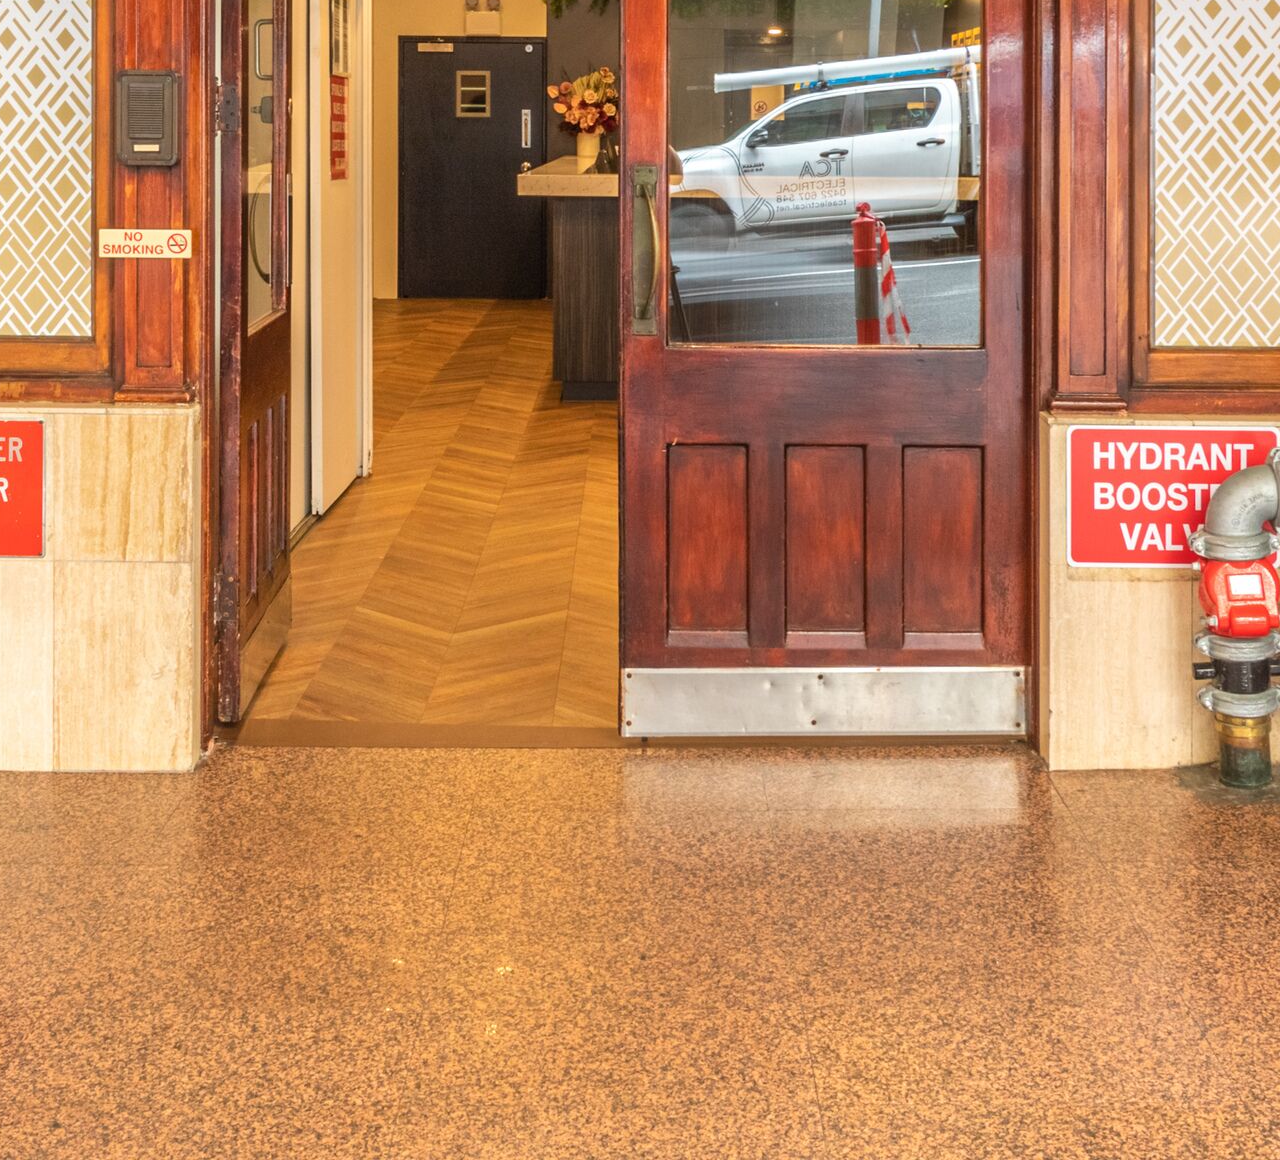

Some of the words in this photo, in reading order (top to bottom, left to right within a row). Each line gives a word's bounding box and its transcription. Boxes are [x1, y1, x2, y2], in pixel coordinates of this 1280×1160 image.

[124, 232, 143, 242] NO
[103, 244, 164, 255] SMOKING
[1093, 442, 1254, 471] HYDRANT
[1093, 482, 1221, 511] BOOST
